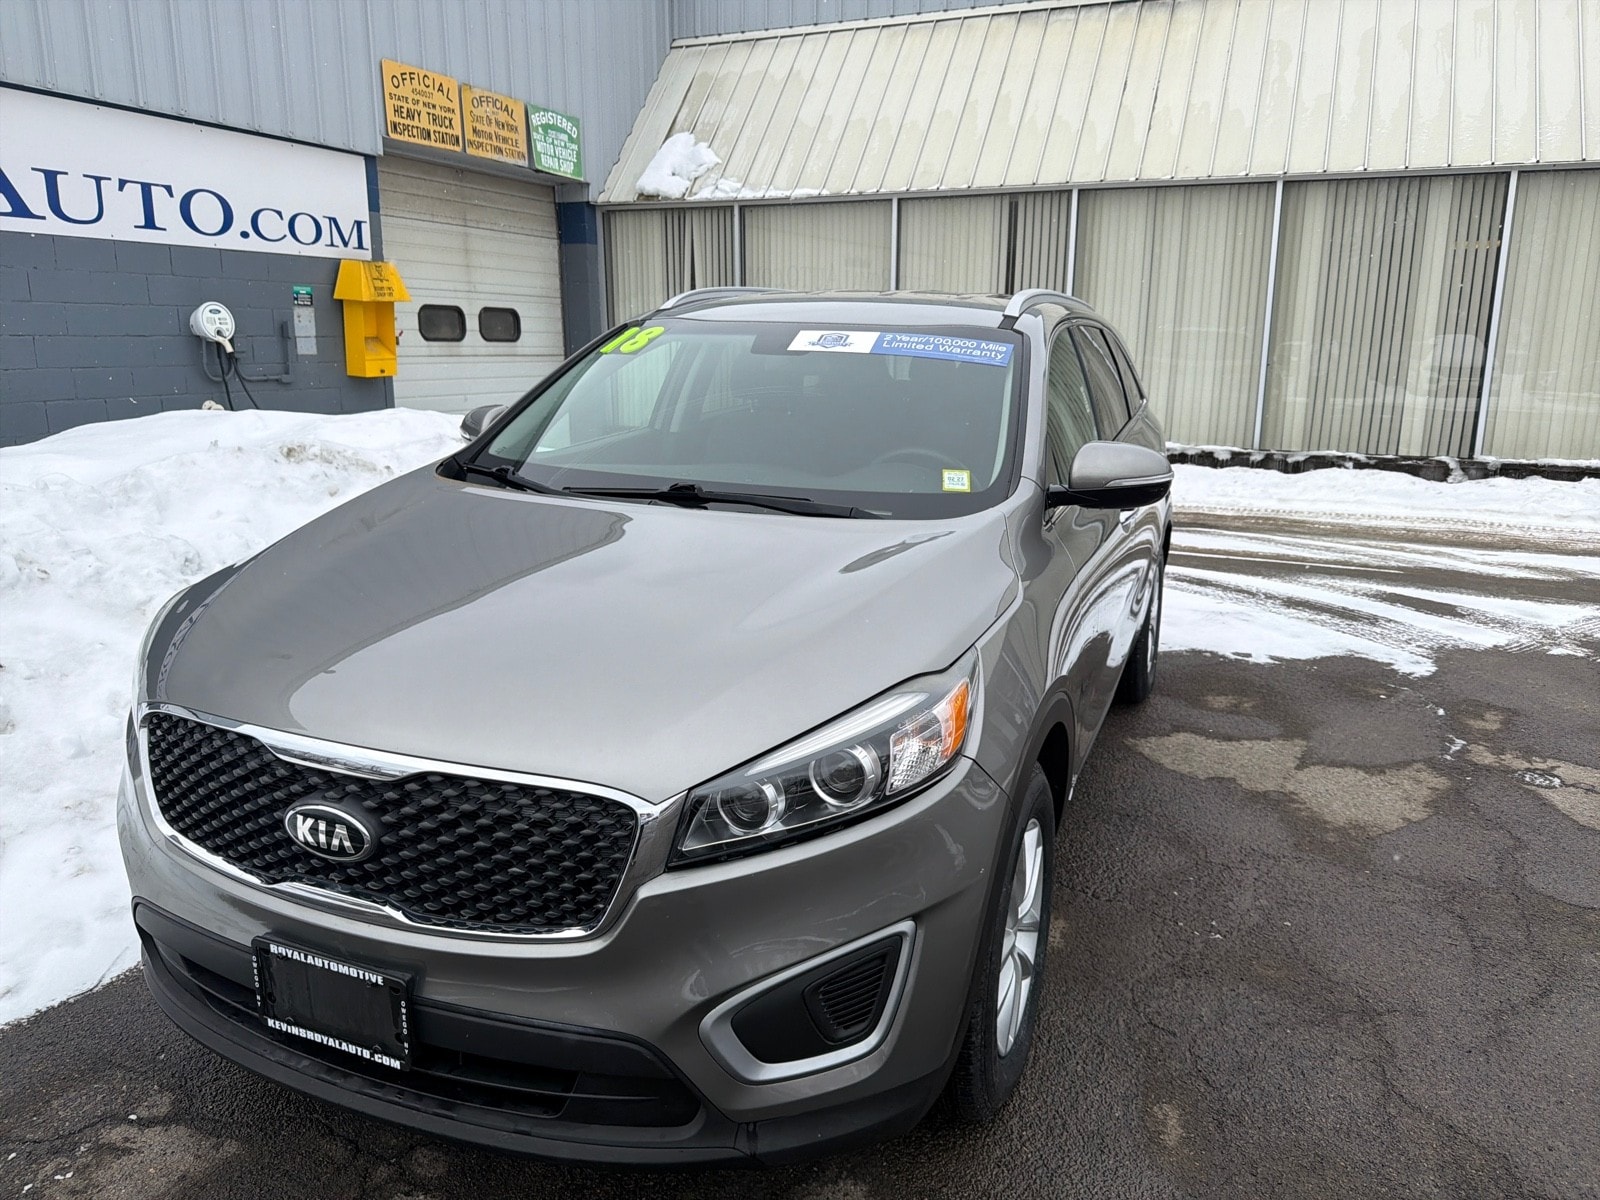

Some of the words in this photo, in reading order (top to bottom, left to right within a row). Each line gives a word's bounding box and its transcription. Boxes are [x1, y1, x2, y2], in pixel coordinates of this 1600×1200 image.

[391, 72, 453, 103] OFFICIAL
[388, 92, 410, 104] STATE
[422, 101, 436, 110] NEW
[439, 105, 456, 115] YORK
[471, 96, 516, 122] OFFICIAL
[393, 104, 422, 123] HEAVY
[426, 112, 454, 130] TRUCK
[470, 110, 485, 126] STATE
[486, 115, 493, 127] OF
[494, 116, 505, 130] NEW
[505, 120, 519, 135] YORK
[531, 112, 578, 139] REGISTERED
[390, 120, 432, 142] INSPECTION
[433, 130, 460, 147] STATION
[472, 125, 493, 141] MOTOR
[494, 130, 519, 149] VEHICLE
[554, 138, 565, 147] NEW
[467, 138, 504, 156] INSPECTION
[504, 147, 526, 162] STATION
[536, 140, 554, 156] MOTOR
[555, 146, 577, 162] VEHICLE
[541, 154, 559, 171] REPAIR
[560, 159, 574, 174] SHOP
[600, 326, 664, 354] 18
[883, 340, 934, 350] Limited
[939, 345, 1004, 360] Warranty
[980, 342, 1007, 352] Mile
[296, 814, 355, 854] KIA
[269, 944, 384, 986] ROYALAUTOMOTIVE
[256, 994, 261, 1007] NY
[267, 1018, 401, 1070] KEVINSROYALAUTO.COM
[404, 1042, 409, 1055] NY
